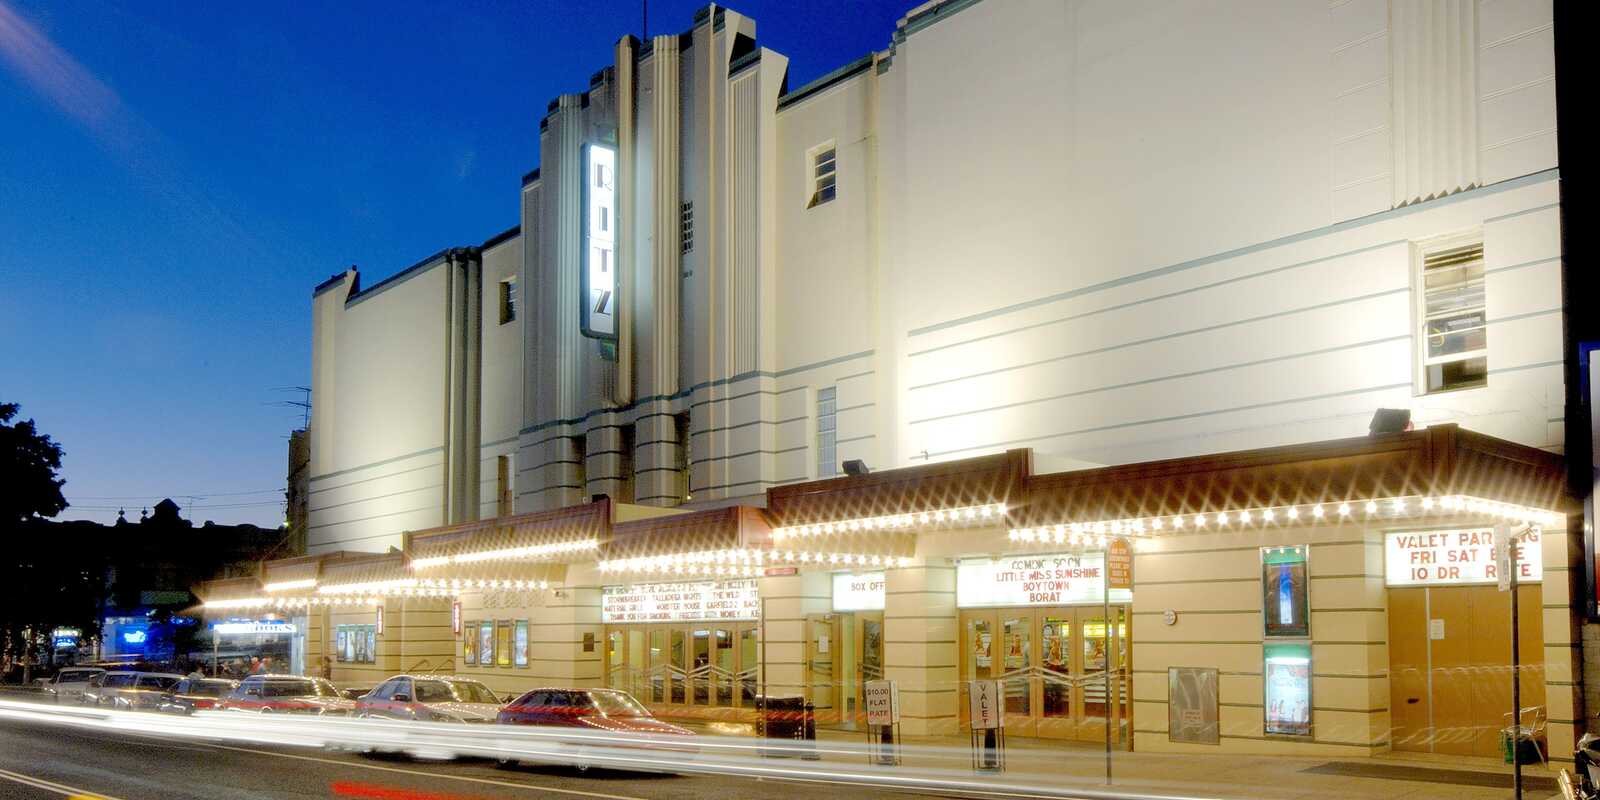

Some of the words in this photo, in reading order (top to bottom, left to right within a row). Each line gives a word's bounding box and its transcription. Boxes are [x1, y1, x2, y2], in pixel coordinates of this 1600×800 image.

[593, 162, 613, 316] RITZ
[1396, 533, 1449, 549] VALET
[1459, 529, 1539, 546] PARNG
[1410, 551, 1437, 564] FRI
[1448, 549, 1478, 562] SAT
[1490, 548, 1526, 561] EE
[1054, 557, 1081, 569] SOON
[996, 572, 1025, 582] LITTLE
[1029, 570, 1052, 581] MISS
[1055, 568, 1100, 579] SUNSHINE
[1438, 566, 1460, 579] DR
[851, 582, 866, 591] BOX
[1023, 581, 1070, 591] BOYTOWN
[1029, 592, 1061, 602] BORAT
[867, 688, 889, 696] $10.00
[979, 684, 988, 727] VALET
[869, 710, 888, 718] RATE
